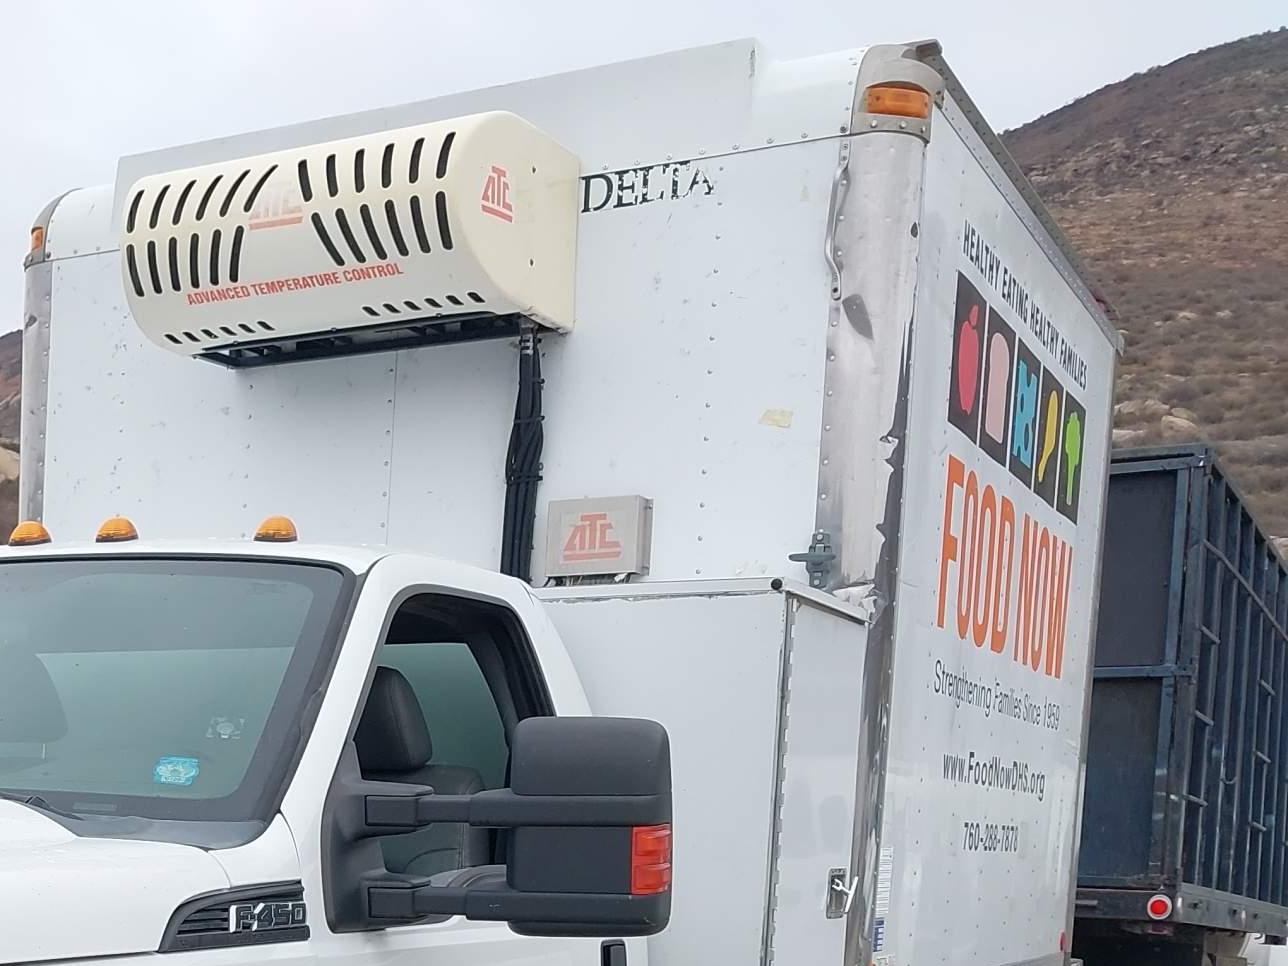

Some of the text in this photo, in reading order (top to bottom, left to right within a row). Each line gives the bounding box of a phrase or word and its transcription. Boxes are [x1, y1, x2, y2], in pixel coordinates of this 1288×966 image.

[579, 160, 715, 213] DELTA
[187, 262, 404, 306] ADVANCED TEMPERATURE CONTROL
[963, 219, 1088, 390] HEALTHY EATING HEALTHY FAMILIES
[936, 454, 1073, 680] FOOD NOW
[933, 659, 1061, 730] Strengthening Families Since 1959
[943, 751, 1045, 802] www.FoodNowDHS.org
